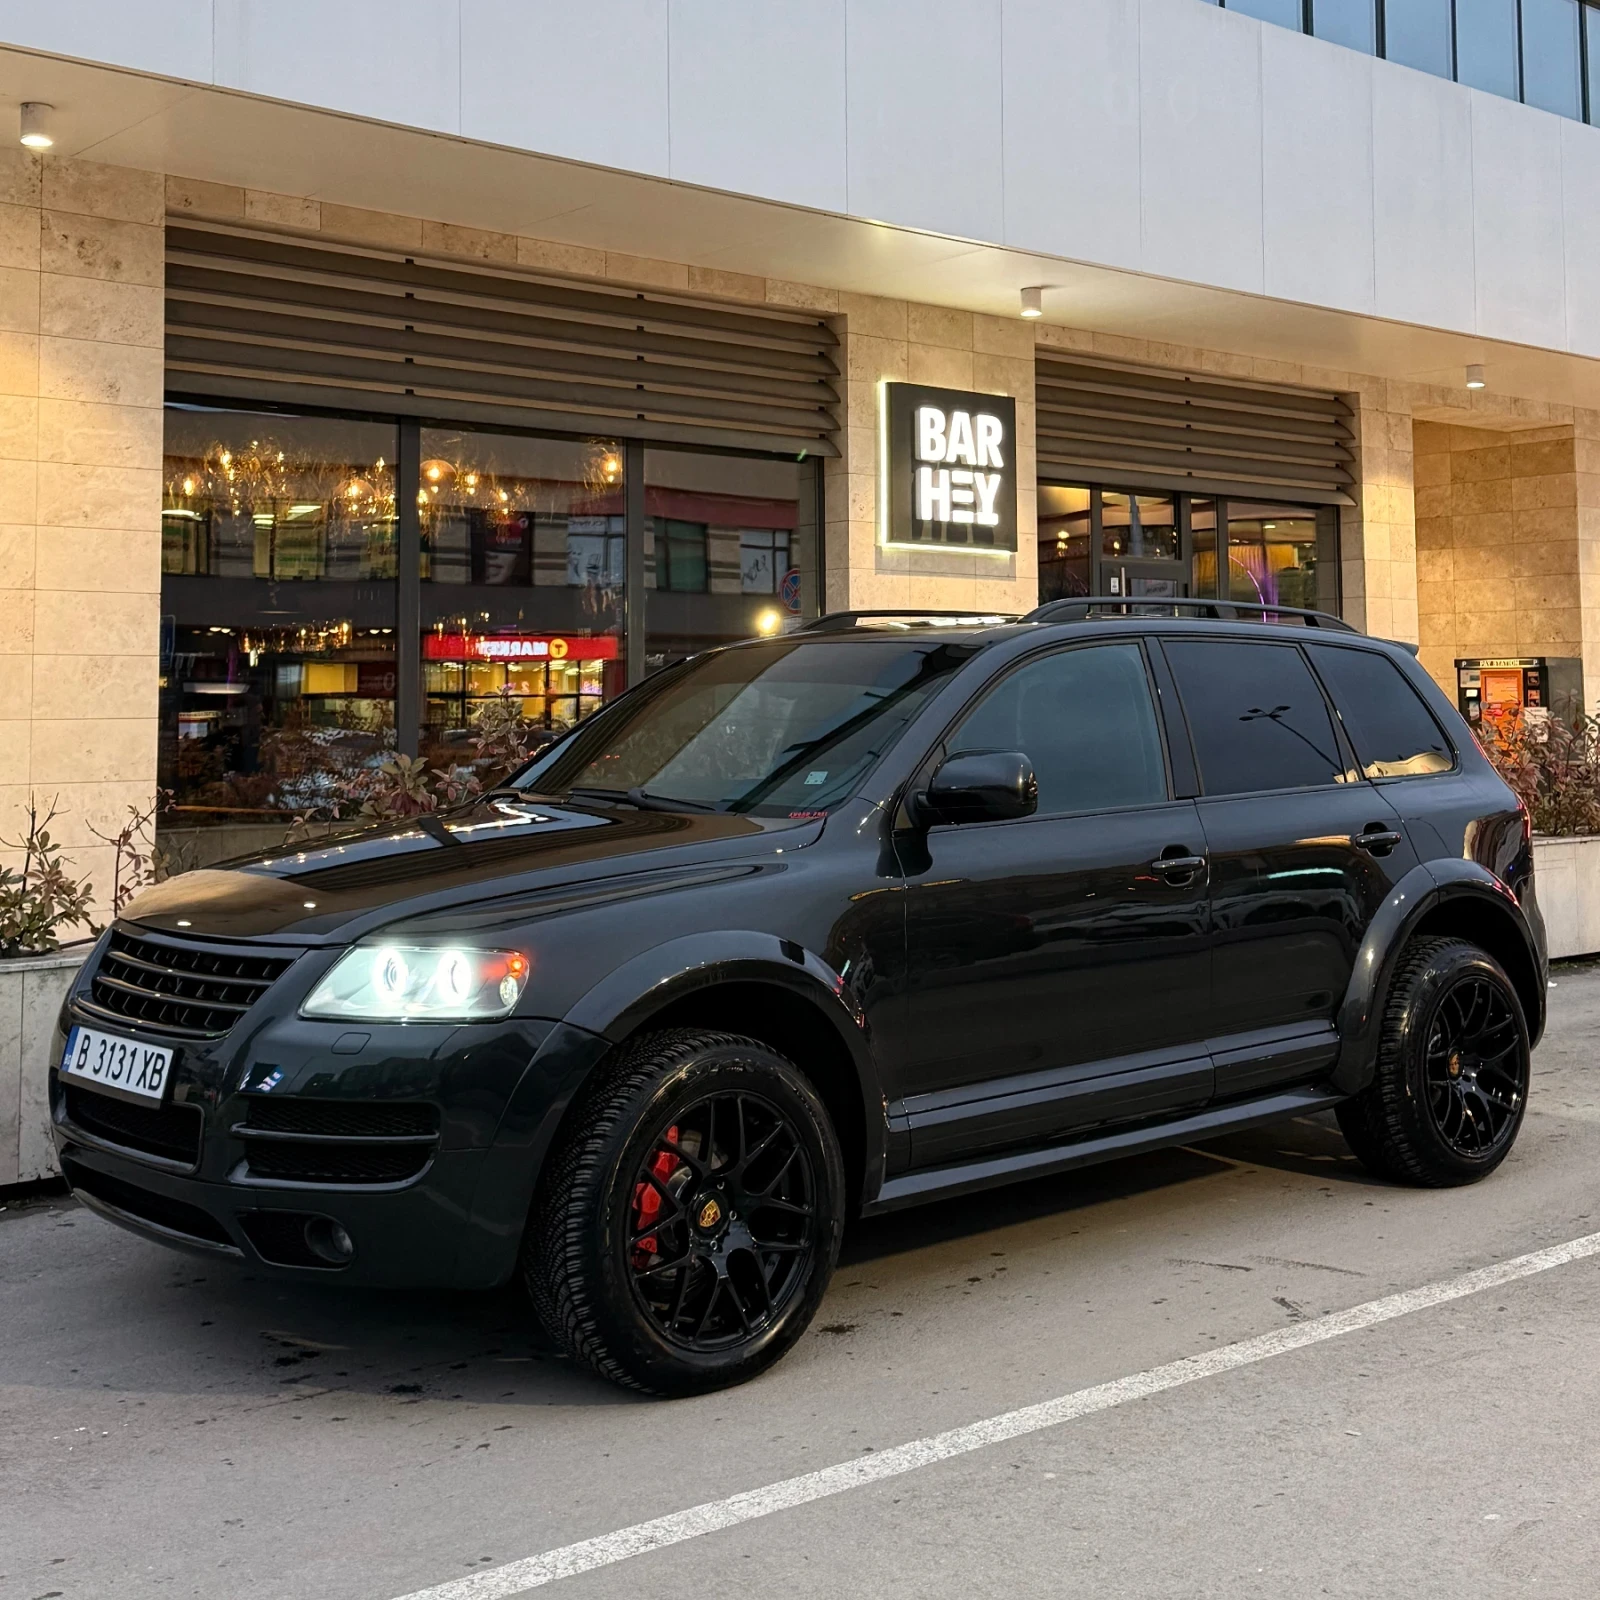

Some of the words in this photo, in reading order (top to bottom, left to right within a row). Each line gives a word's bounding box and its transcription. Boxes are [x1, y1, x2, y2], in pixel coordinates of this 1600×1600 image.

[916, 407, 1004, 468] BAR
[915, 467, 1001, 525] HEY
[76, 1034, 91, 1070] B
[92, 1039, 138, 1084] 3131
[135, 1050, 166, 1091] XB
